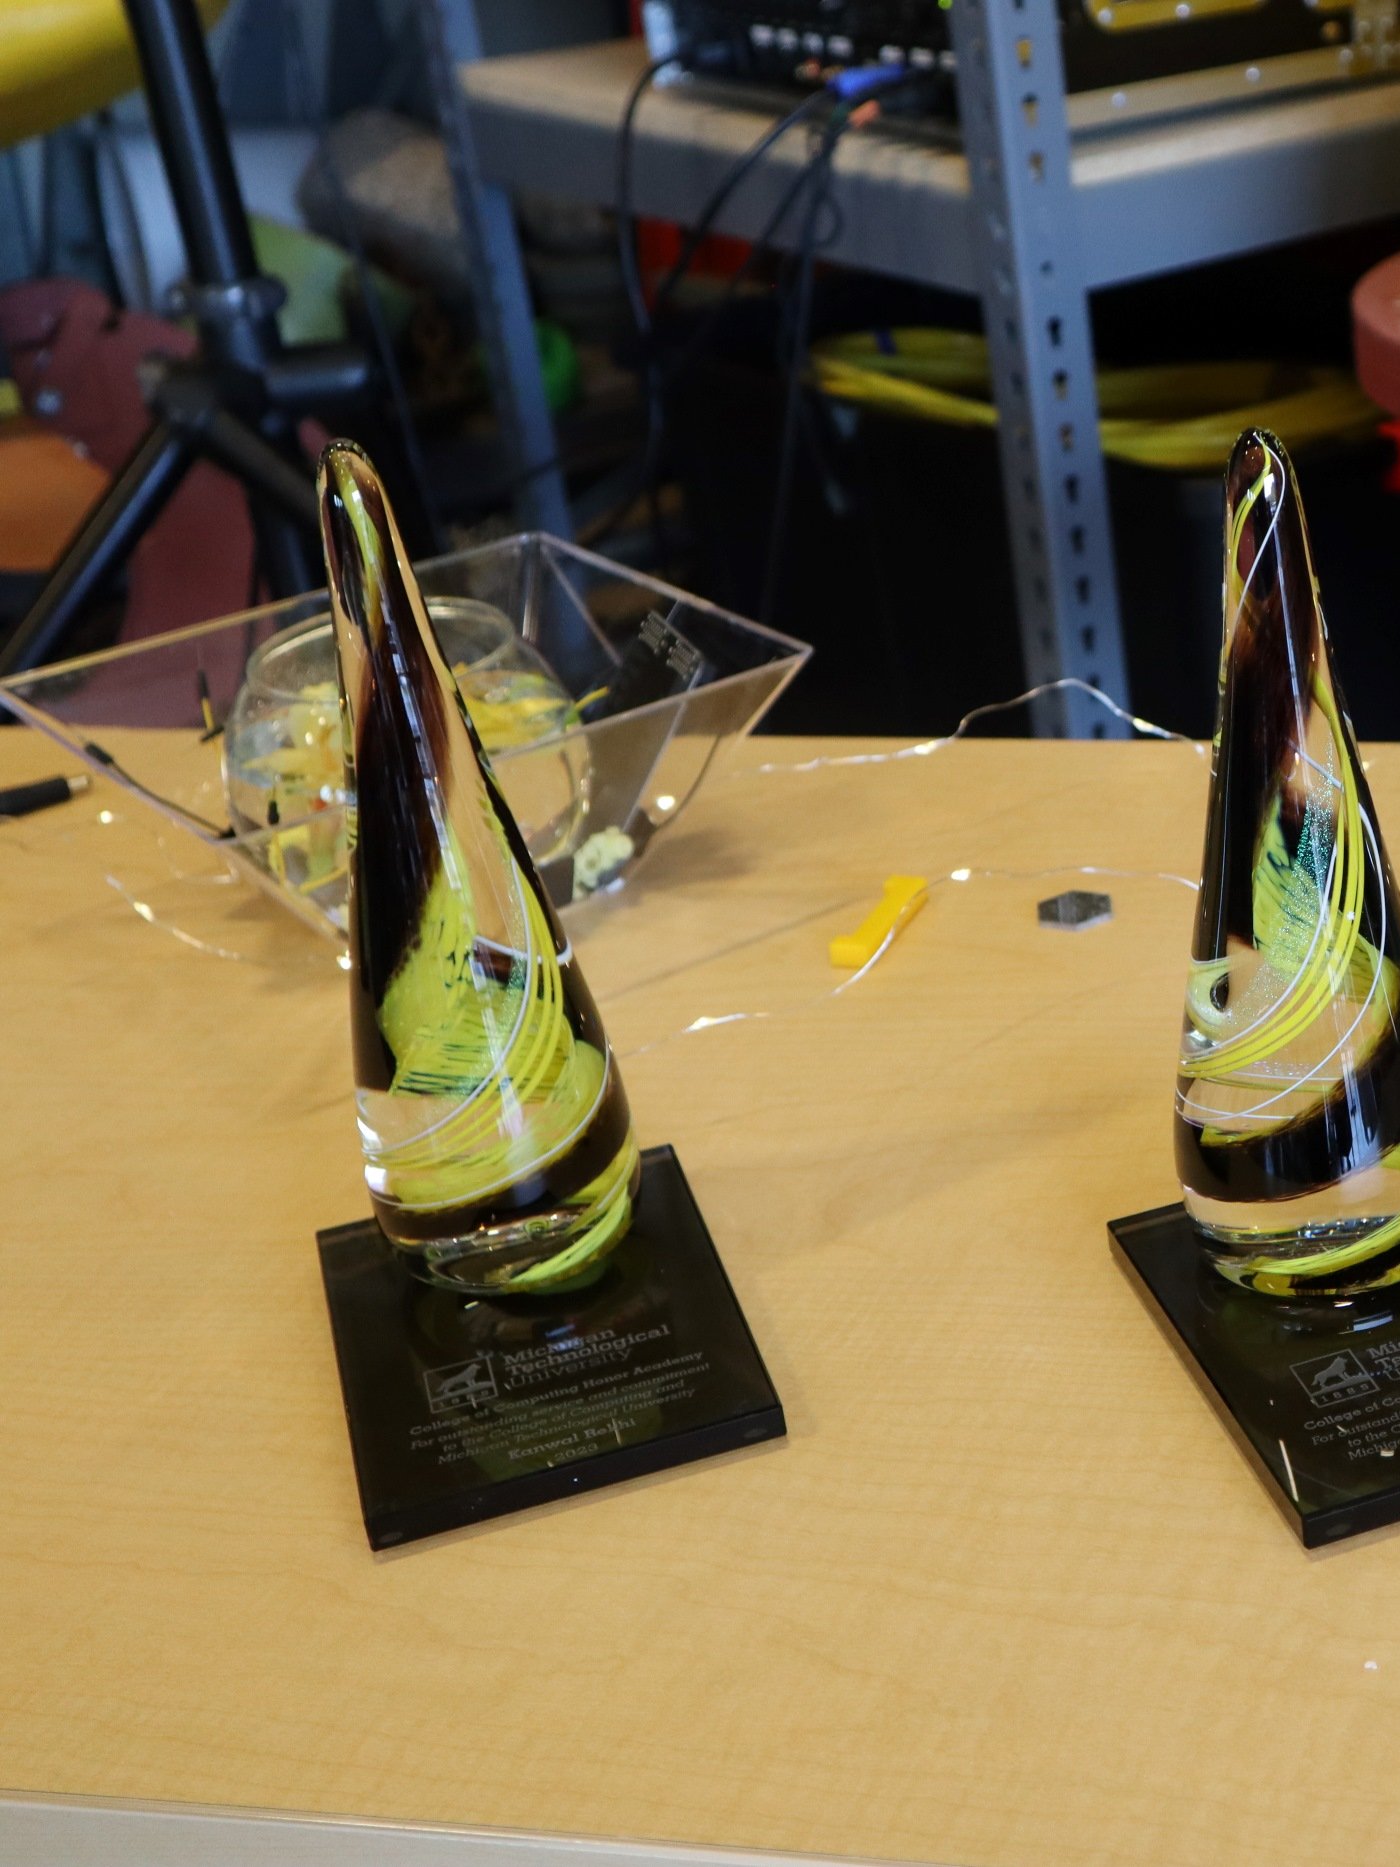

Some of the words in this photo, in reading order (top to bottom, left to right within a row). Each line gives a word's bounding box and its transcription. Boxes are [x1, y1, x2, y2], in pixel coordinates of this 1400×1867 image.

[503, 1329, 616, 1365] Michigan
[505, 1323, 671, 1375] Technological
[510, 1347, 632, 1387] University
[410, 1415, 470, 1435] College
[474, 1408, 489, 1419] of
[493, 1385, 579, 1412] Computing
[582, 1371, 629, 1389] Honor
[633, 1352, 702, 1375] Academy
[410, 1439, 433, 1450] For
[438, 1413, 527, 1442] outstanding
[588, 1387, 617, 1401] and
[620, 1362, 710, 1392] commitment
[622, 1388, 696, 1414] University
[443, 1443, 457, 1452] to
[462, 1436, 485, 1447] the
[489, 1420, 548, 1439] College
[570, 1390, 653, 1417] Computing
[656, 1379, 684, 1394] and
[1303, 1409, 1361, 1430] College
[1364, 1402, 1380, 1413] of
[508, 1433, 579, 1459] Kanwal
[1312, 1434, 1334, 1445] For
[1348, 1438, 1361, 1447] to
[1365, 1430, 1388, 1443] the
